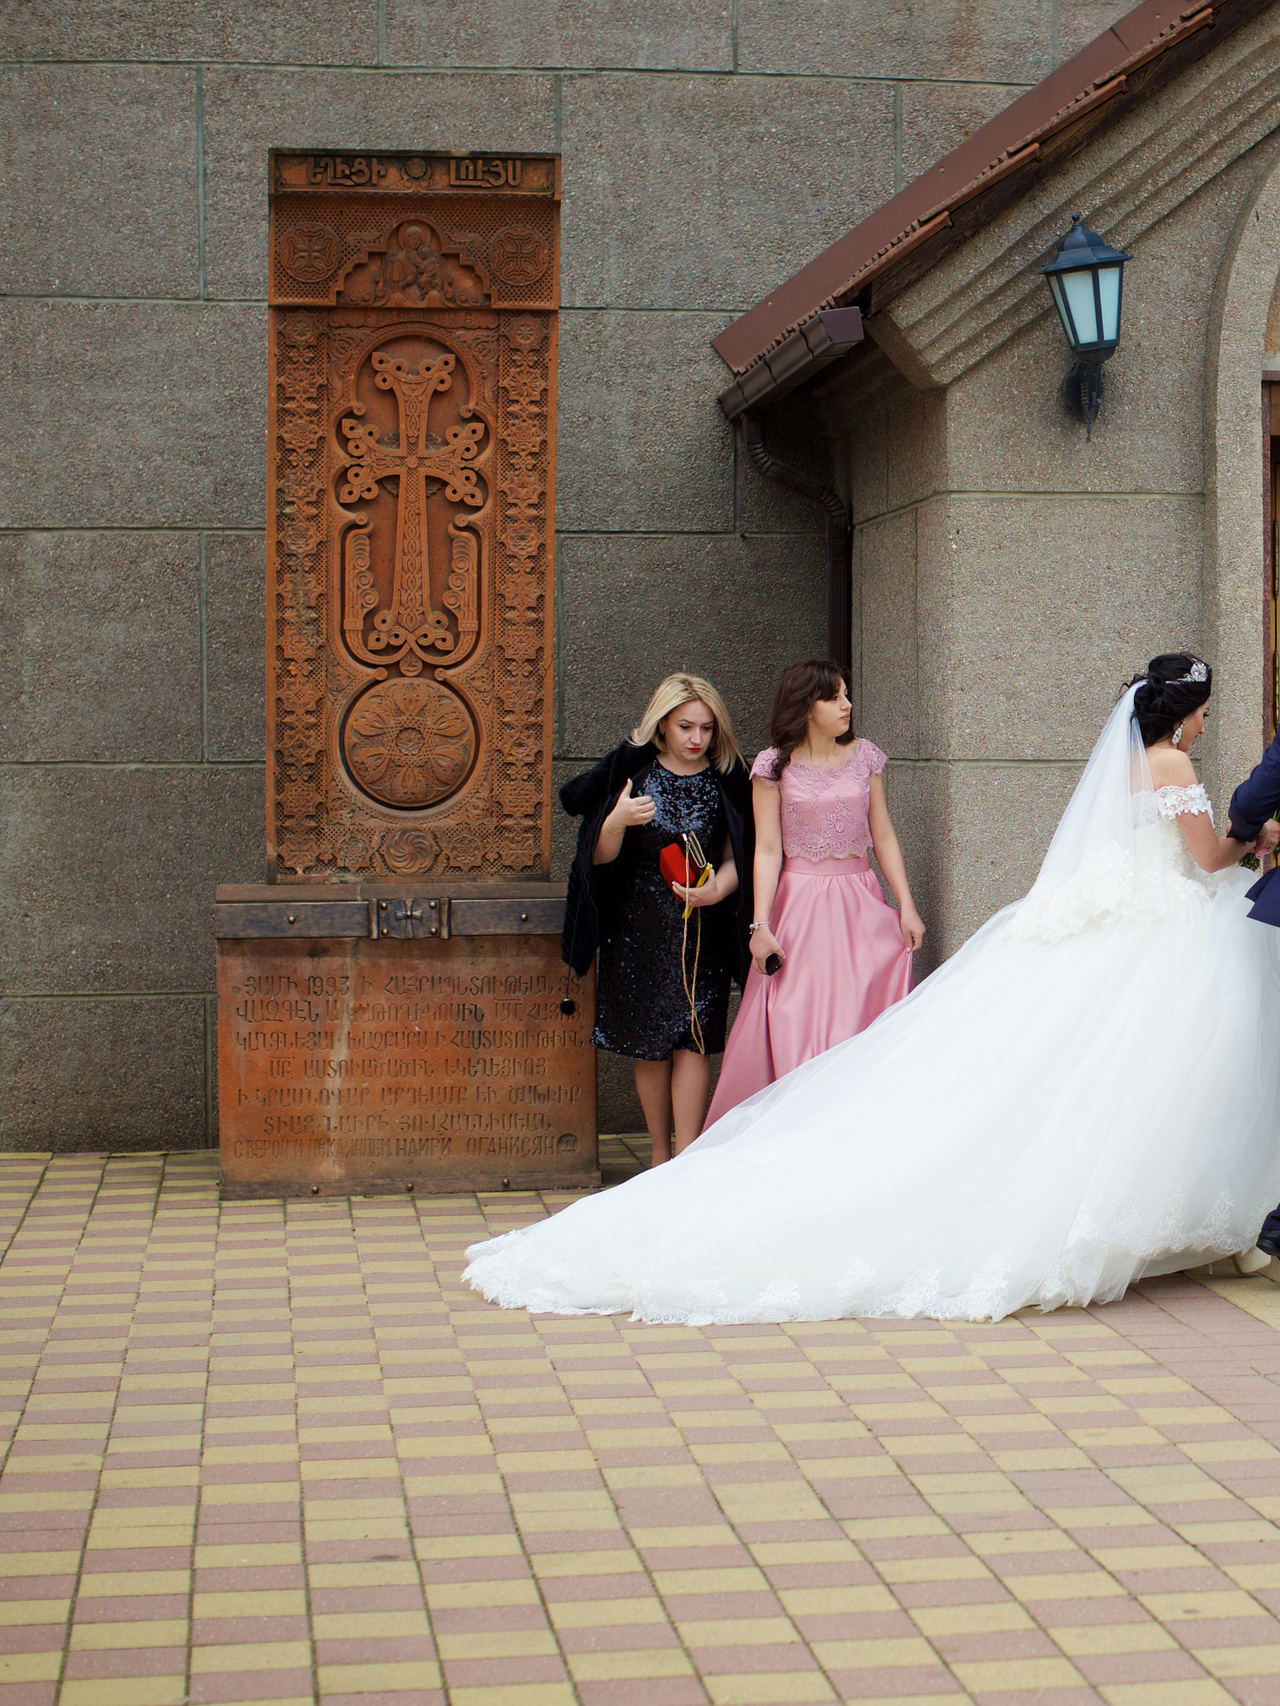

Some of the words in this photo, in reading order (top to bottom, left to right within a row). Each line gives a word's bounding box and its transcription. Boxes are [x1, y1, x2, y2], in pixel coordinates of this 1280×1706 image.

[307, 156, 387, 186] ԵՂԻՑԻ
[449, 158, 522, 188] ԼՈՒՅՍ
[243, 975, 298, 997] ՅԱՄԻ
[305, 975, 350, 997] 1993
[361, 975, 373, 997] Ի
[383, 975, 554, 997] ՀԱՅՐԱՊԵՏՈՒԹԵԱՆ
[235, 998, 320, 1023] ՎԱԶԳԷՆ
[346, 1001, 485, 1023] ԿԱԹՈՂԻԿՈՍԻՆ
[233, 1139, 243, 1160] С
[308, 1137, 392, 1160] ПОКАЯНИЕМ
[396, 1136, 452, 1158] НАИРИ
[466, 1135, 556, 1157] ОГАНИСЯН
